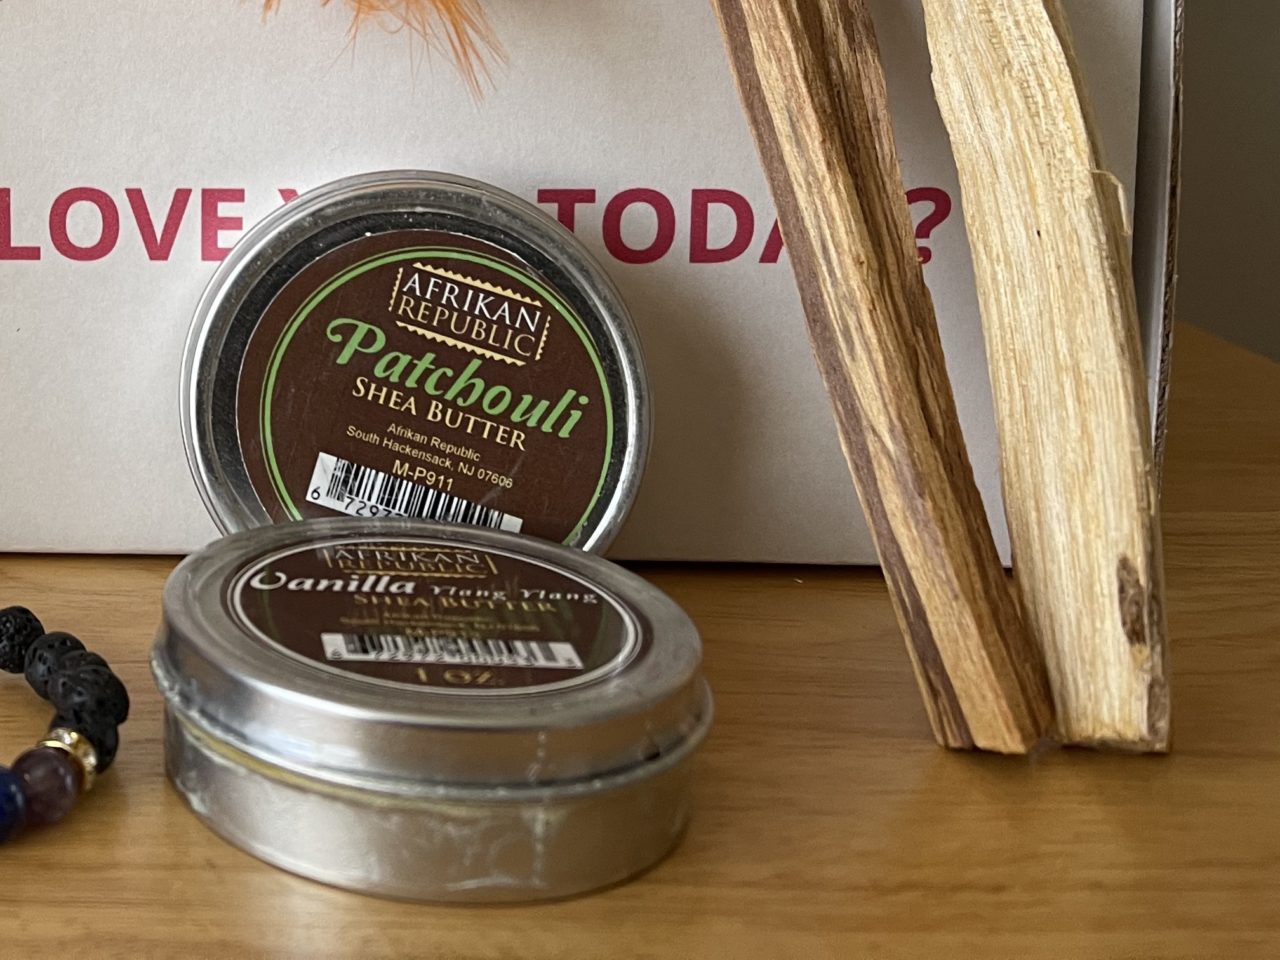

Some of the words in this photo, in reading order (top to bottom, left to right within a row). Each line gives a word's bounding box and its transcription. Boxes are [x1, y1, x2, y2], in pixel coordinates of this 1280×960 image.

[537, 186, 952, 265] TOD?
[401, 271, 542, 334] AFRIKAN
[397, 295, 538, 358] REPUBLIC
[326, 316, 590, 439] Patchouli
[351, 375, 418, 417] SHEA
[426, 399, 527, 452] BUTTER
[345, 424, 381, 446] South
[382, 434, 455, 472] Hackensack,
[457, 461, 476, 477] NJ
[476, 467, 514, 489] 07606
[386, 422, 429, 445] Afrikan
[429, 436, 482, 463] Republic
[310, 486, 321, 501] 6
[391, 459, 455, 492] M-P911
[335, 549, 480, 564] AFRIKAN
[337, 559, 489, 575] REPUBLIC
[249, 570, 417, 595] Vanilla
[429, 584, 507, 601] Ylang
[520, 588, 599, 605] Ylang
[353, 593, 431, 607] SHEA
[440, 596, 558, 613] BUTTER
